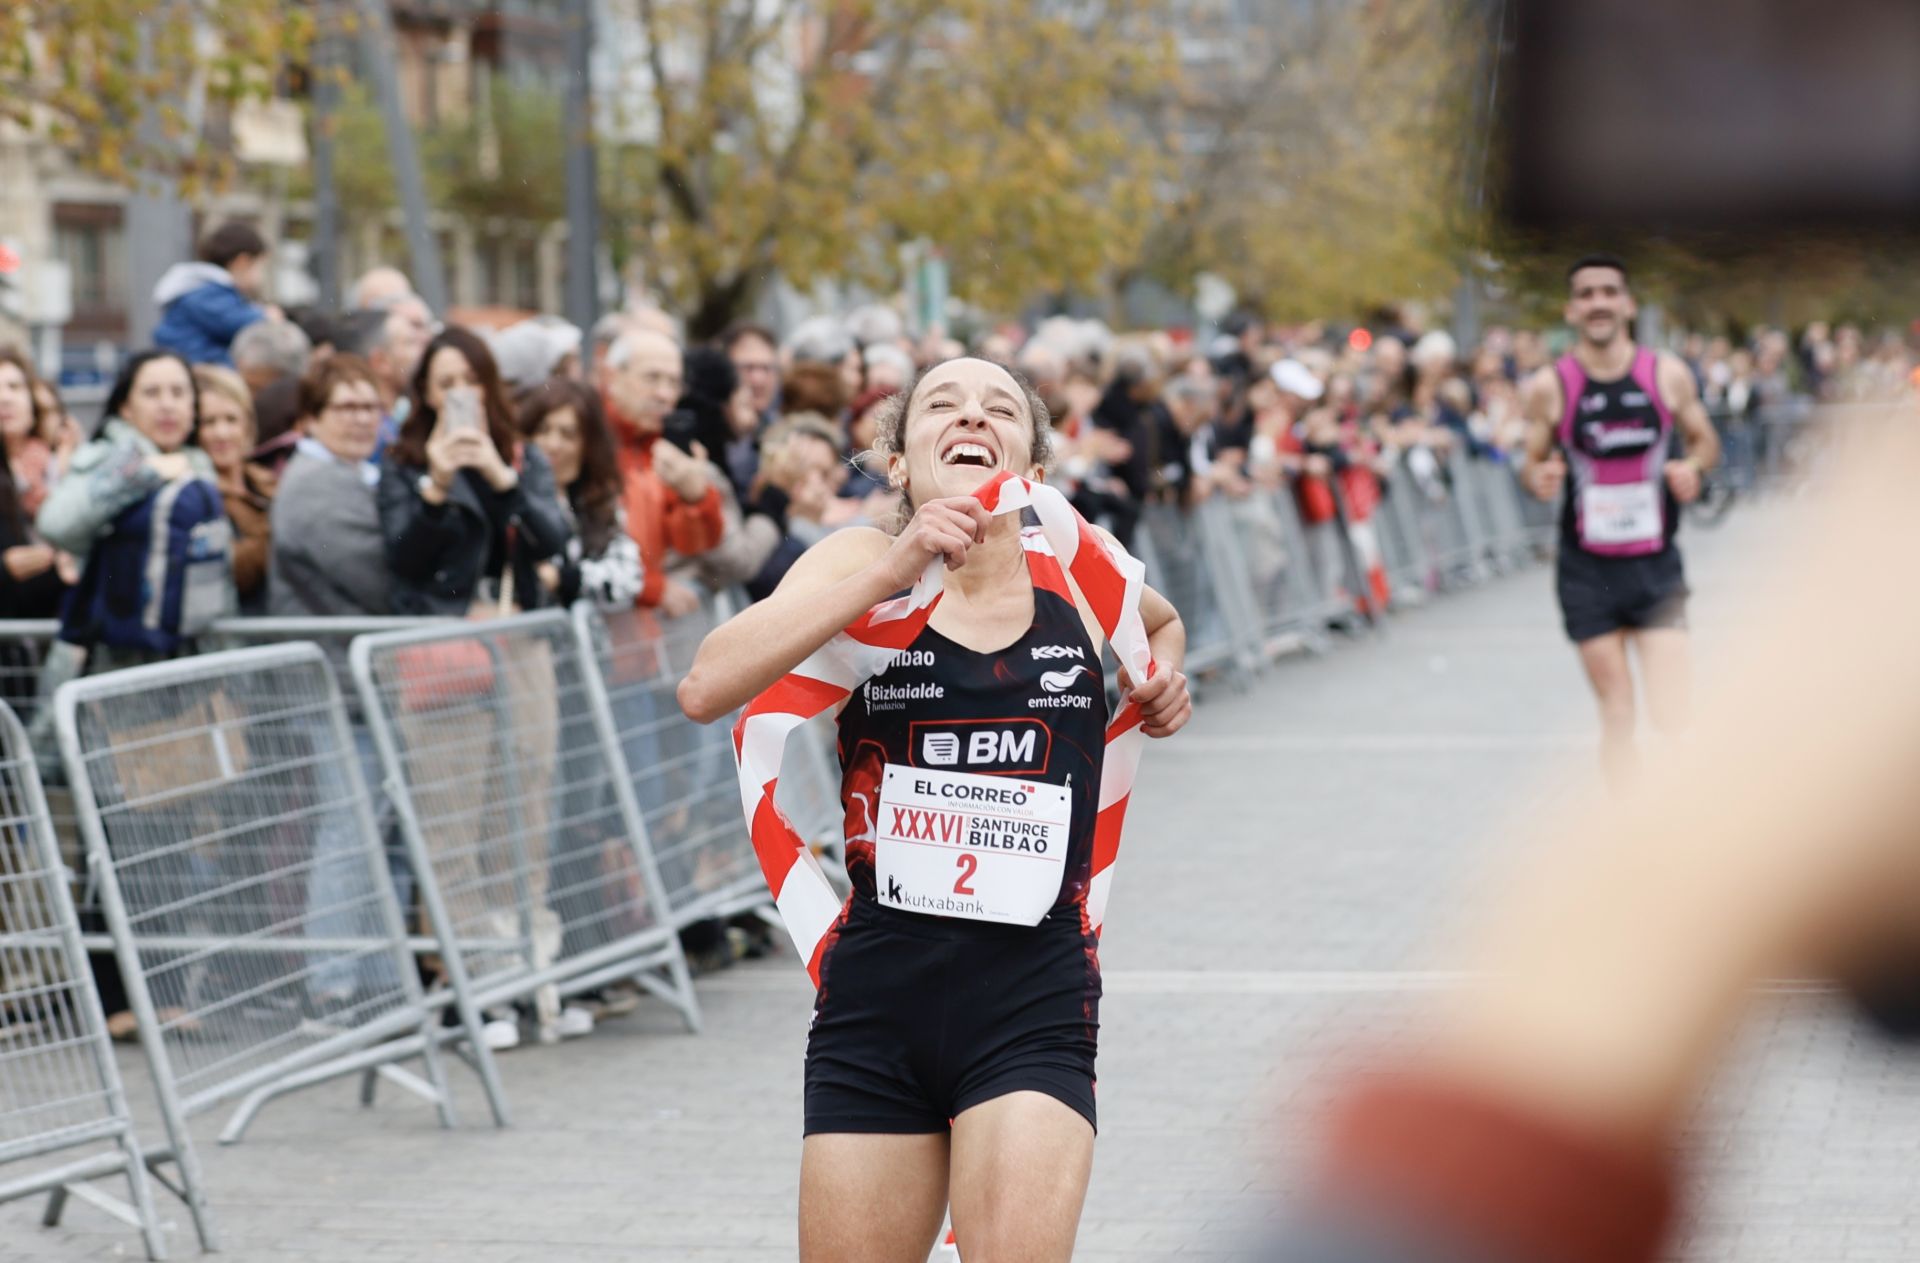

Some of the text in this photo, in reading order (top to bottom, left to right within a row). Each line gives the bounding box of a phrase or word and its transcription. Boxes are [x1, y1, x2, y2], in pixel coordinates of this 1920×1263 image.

[890, 650, 935, 668] lbao
[871, 683, 944, 701] Bizkaialde
[1028, 695, 1092, 709] emteSPORT
[872, 701, 906, 712] fundazioa
[967, 729, 1036, 764] BM
[914, 780, 1027, 806] EL CORREO
[997, 804, 1012, 814] CON
[1012, 807, 1034, 817] VALOR
[890, 807, 963, 844] XXXVI
[971, 817, 1049, 838] SANTURCE
[969, 831, 1047, 853] BILBAO
[953, 853, 977, 896] 2
[904, 891, 984, 915] kutxabank
